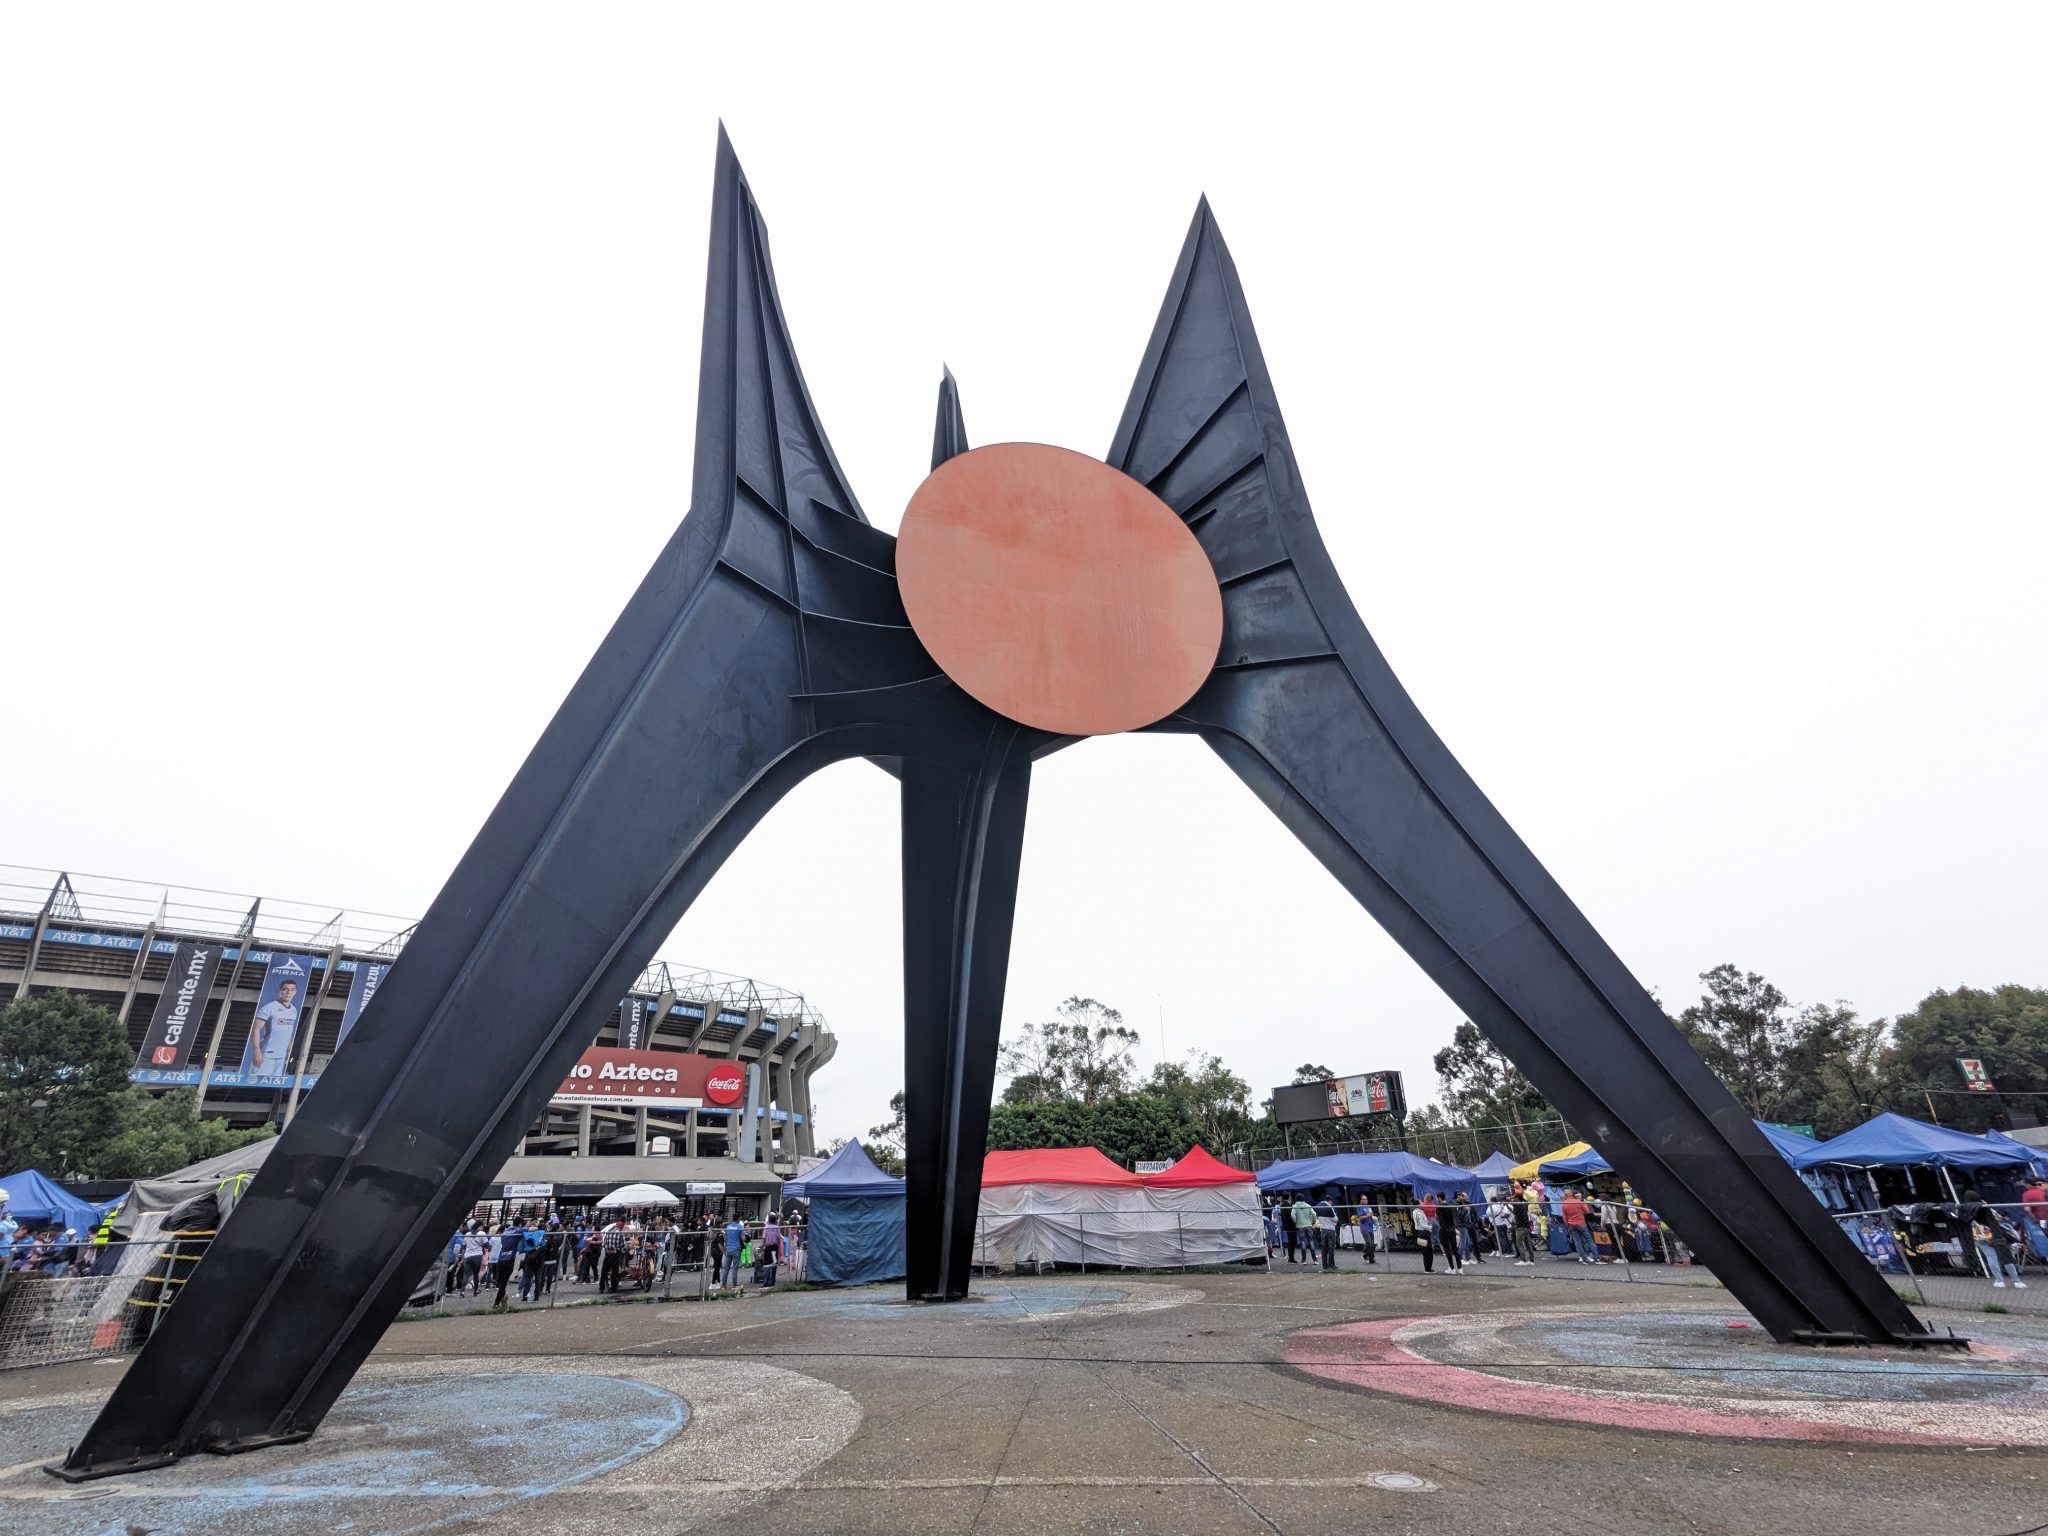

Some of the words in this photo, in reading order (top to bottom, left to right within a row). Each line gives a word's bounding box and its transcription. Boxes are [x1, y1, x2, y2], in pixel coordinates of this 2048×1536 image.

[52, 933, 86, 943] AT&T
[103, 937, 136, 948] AT&T
[155, 943, 178, 952] AT&
[339, 961, 357, 971] AT&
[271, 968, 305, 977] PIRMA
[365, 964, 380, 989] AZUL
[164, 949, 209, 1045] caliente.mx
[598, 1061, 678, 1082] Azteca
[162, 1072, 193, 1082] AT&T
[214, 1074, 244, 1083] AT&T
[260, 1076, 288, 1085] AT&T
[552, 1095, 633, 1103] ww.estadioazteca.com.mx
